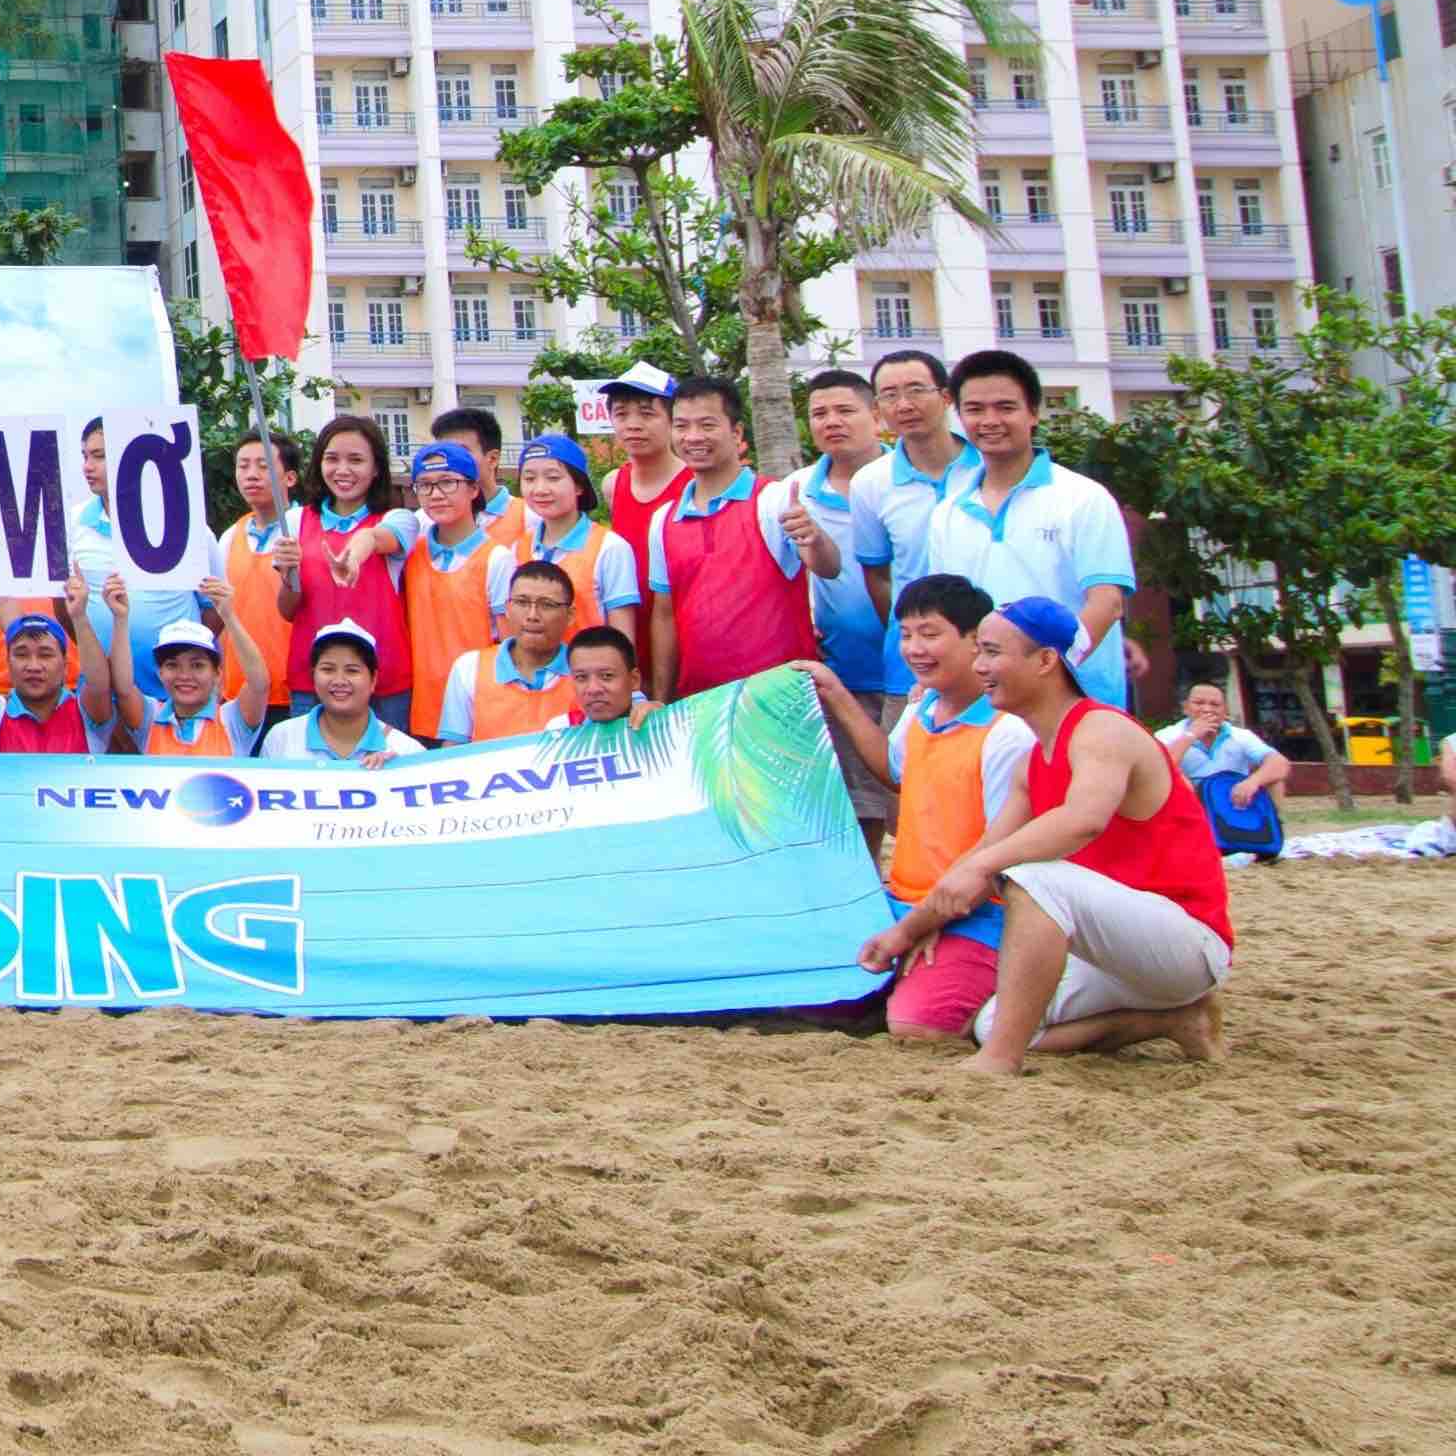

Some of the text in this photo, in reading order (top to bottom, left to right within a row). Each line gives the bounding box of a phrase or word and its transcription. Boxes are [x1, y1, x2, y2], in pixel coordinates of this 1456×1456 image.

[390, 753, 642, 809] TRAVEL
[312, 804, 576, 842] Timeless Discovery
